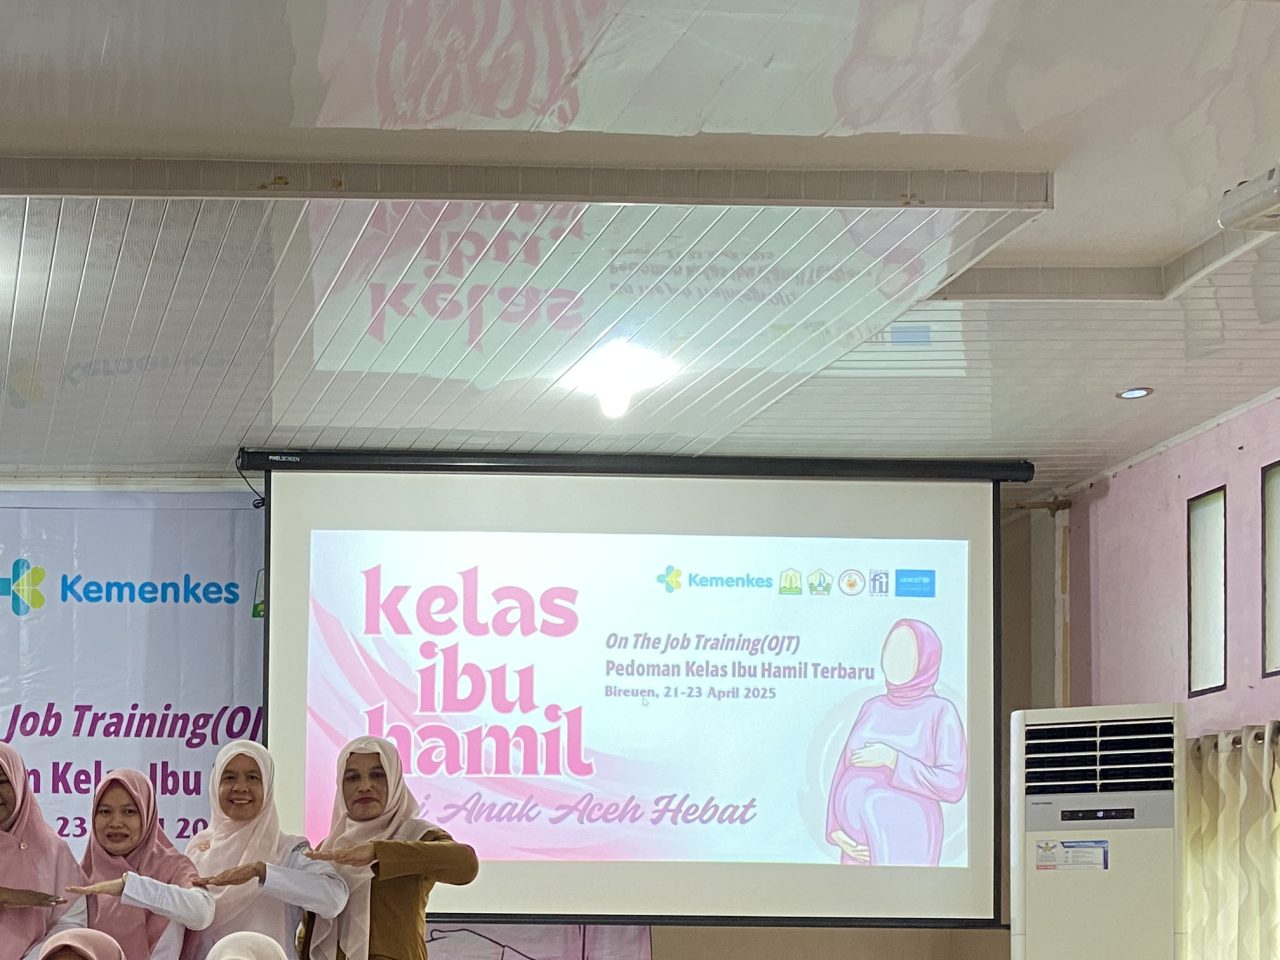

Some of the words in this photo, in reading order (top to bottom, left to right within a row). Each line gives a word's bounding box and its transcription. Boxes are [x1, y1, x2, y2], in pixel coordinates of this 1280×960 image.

[60, 573, 240, 605] Kemenkes
[688, 573, 774, 588] Kemenkes
[360, 564, 579, 637] kelas
[605, 633, 628, 650] On
[632, 633, 661, 650] The
[660, 633, 691, 654] Job
[694, 634, 801, 655] Training(OJT)
[415, 641, 539, 715] ibu
[605, 660, 681, 677] Pedoman
[685, 661, 728, 678] Kelas
[732, 661, 757, 678] Ibu
[761, 661, 808, 680] Hamil
[812, 662, 875, 680] Terbaru
[604, 685, 659, 699] Bireuen,
[663, 686, 703, 698] 21-23
[707, 687, 740, 701] April
[744, 687, 776, 699] 2025
[0, 703, 62, 743] Job
[72, 703, 263, 748] Training(OJ
[362, 703, 598, 777] hamil
[150, 761, 202, 796] Ibu
[436, 792, 541, 825] Anak
[549, 792, 645, 825] Aceh
[650, 793, 758, 825] Hebat
[175, 818, 209, 839] 20
